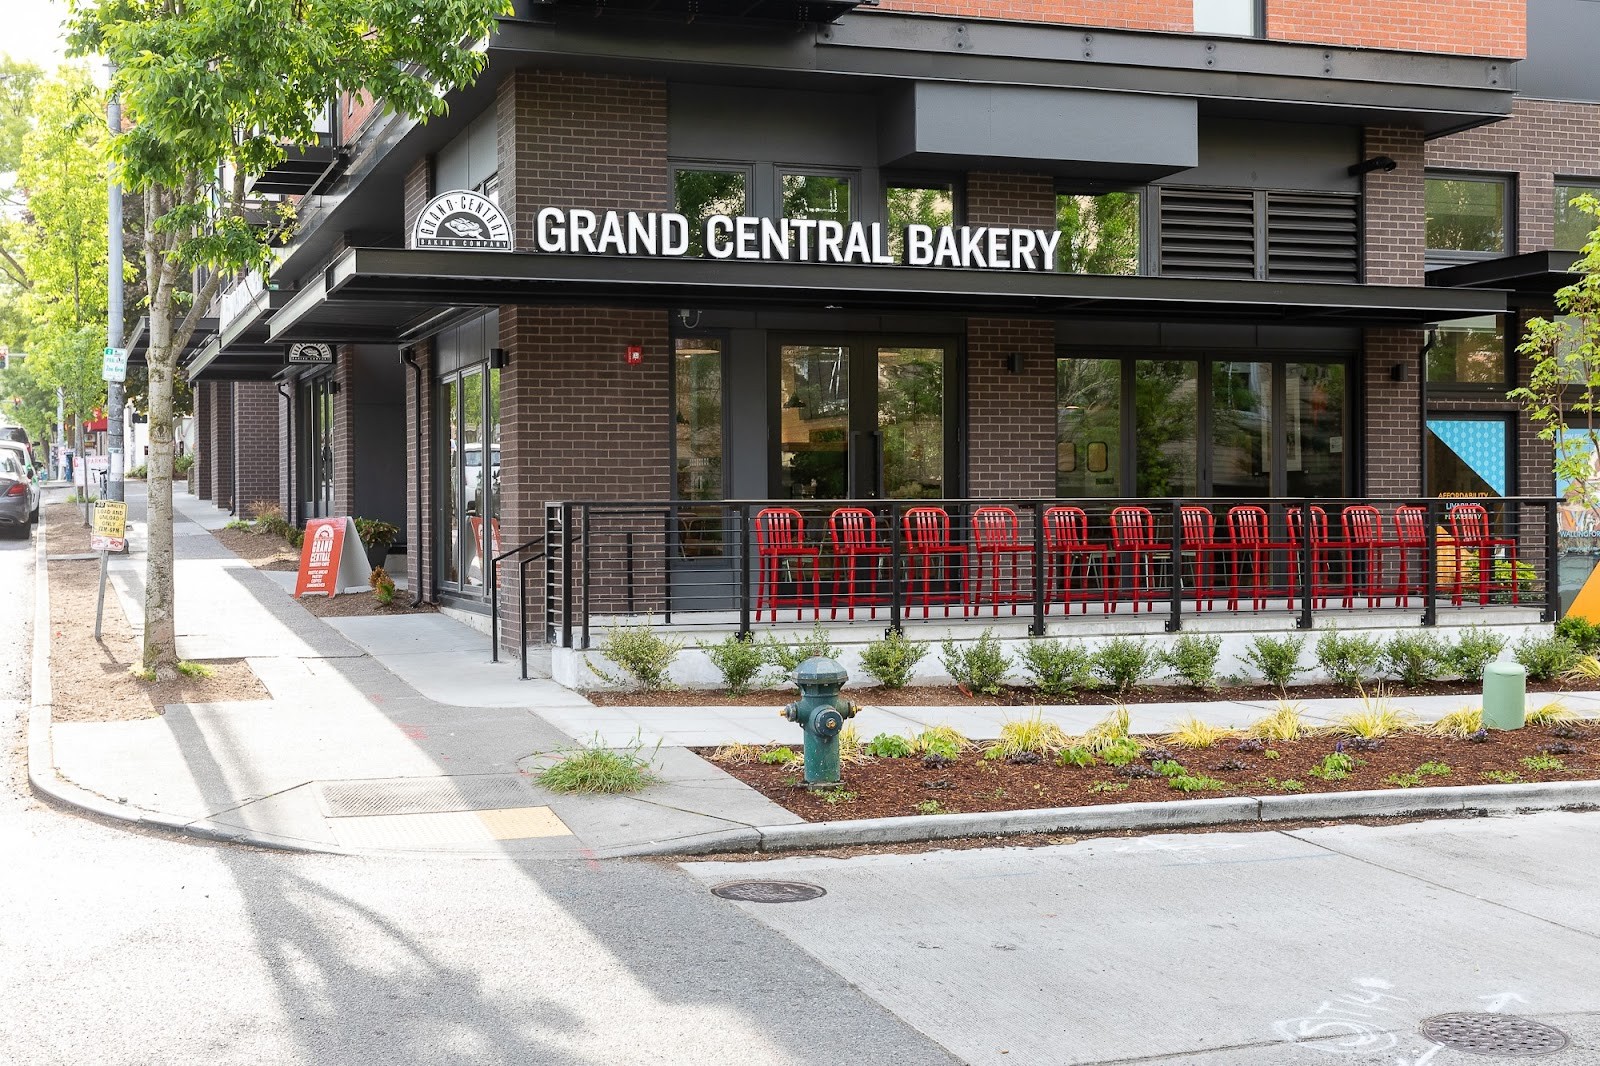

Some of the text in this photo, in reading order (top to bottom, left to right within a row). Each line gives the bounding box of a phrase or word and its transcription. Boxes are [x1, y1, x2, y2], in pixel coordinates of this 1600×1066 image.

[420, 195, 506, 237] GRAND CENTRAL
[463, 240, 507, 248] COMPANY
[537, 207, 1062, 270] GRAND CENTRAL BAKERY
[312, 540, 334, 553] GRAND
[310, 553, 331, 562] CENTRAL
